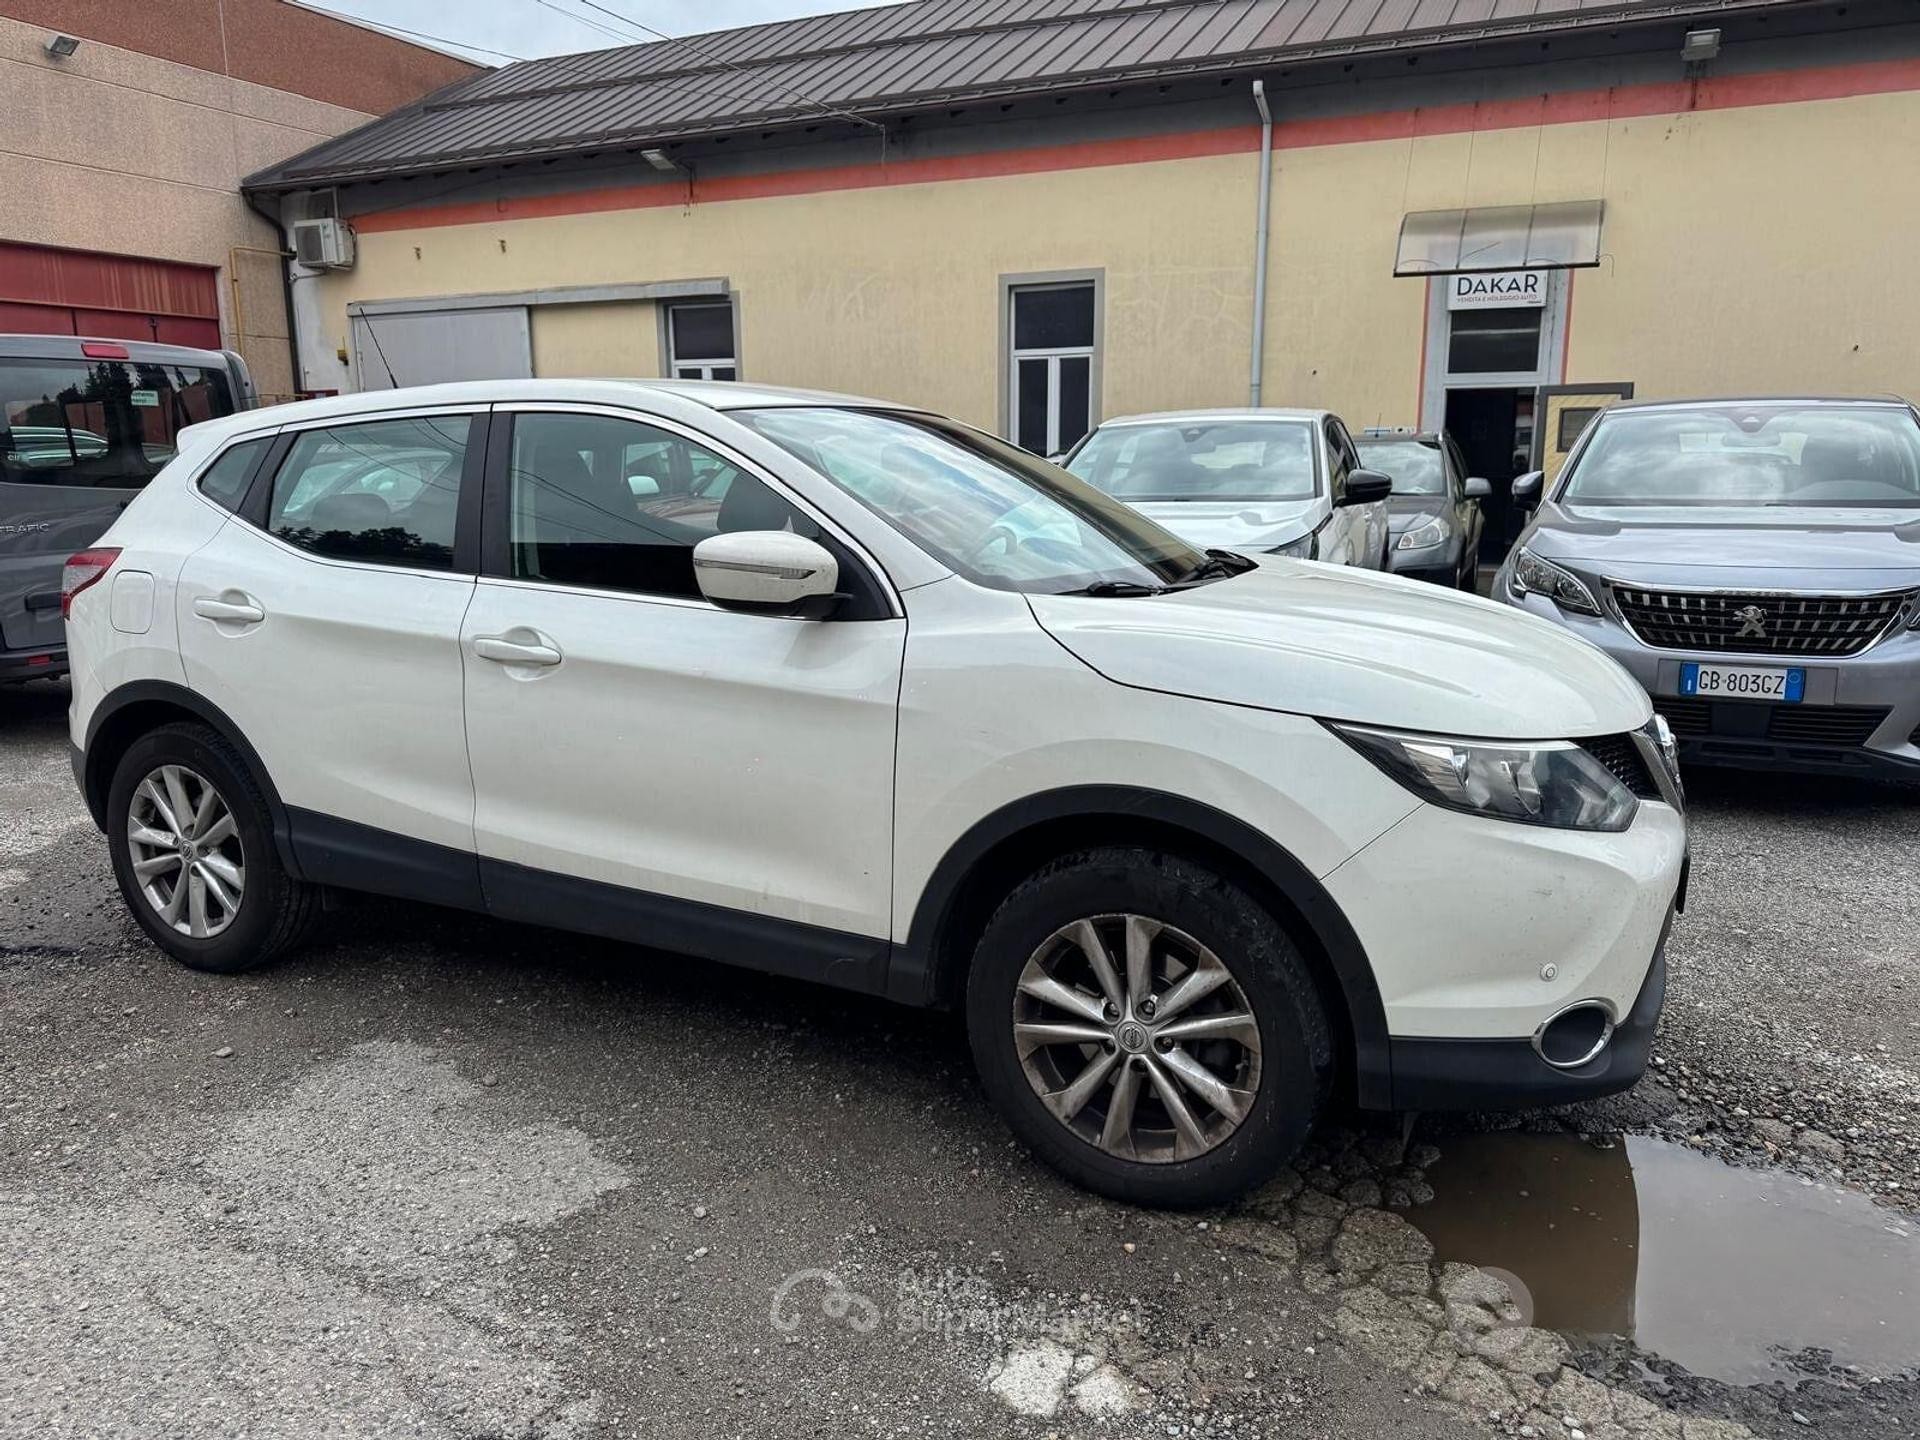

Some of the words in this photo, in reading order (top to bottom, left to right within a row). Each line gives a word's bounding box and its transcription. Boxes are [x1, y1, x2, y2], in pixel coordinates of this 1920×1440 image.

[1457, 274, 1538, 296] DAKAR
[1699, 670, 1720, 690] GB
[1726, 673, 1785, 694] 803GZ
